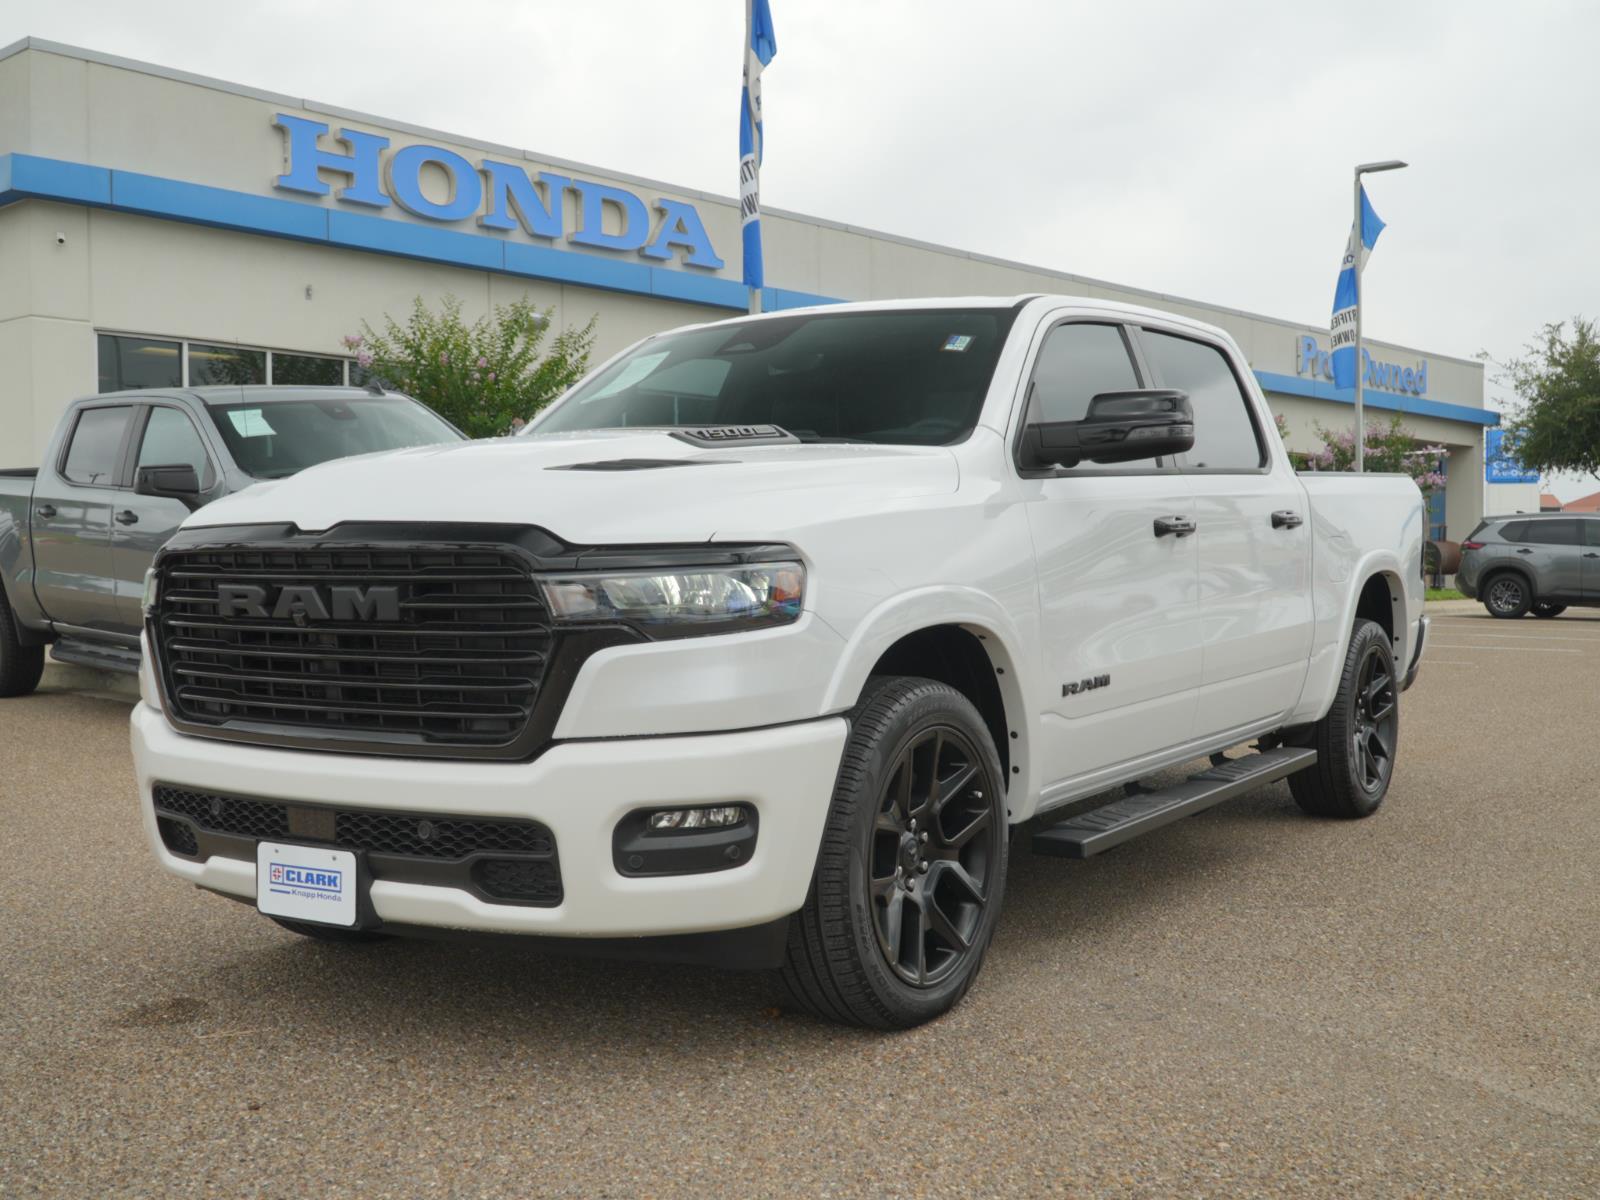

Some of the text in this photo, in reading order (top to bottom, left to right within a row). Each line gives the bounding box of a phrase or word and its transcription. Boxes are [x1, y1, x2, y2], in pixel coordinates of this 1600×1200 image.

[272, 113, 724, 270] HONDA
[700, 427, 756, 439] 1500
[218, 584, 400, 621] RAM
[1062, 674, 1110, 697] RAM
[286, 869, 339, 888] CLARK
[290, 888, 343, 903] Knapp Honda
